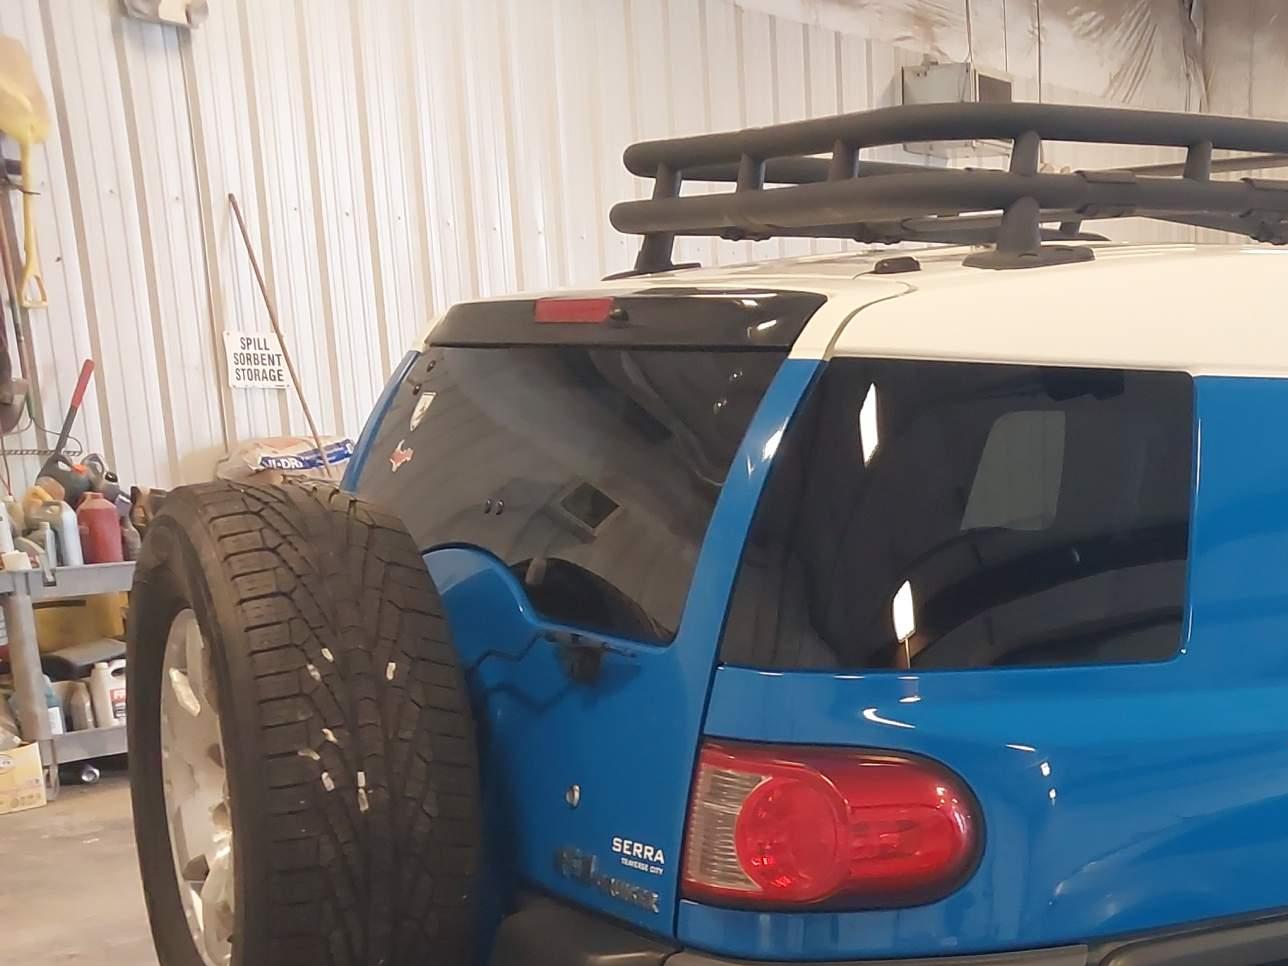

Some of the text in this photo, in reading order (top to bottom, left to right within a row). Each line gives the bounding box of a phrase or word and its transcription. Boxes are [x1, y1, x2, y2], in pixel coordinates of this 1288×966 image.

[239, 336, 270, 351] SPILL
[233, 352, 282, 367] SORBENT
[235, 368, 285, 382] STORAGE
[612, 837, 665, 864] SERRA
